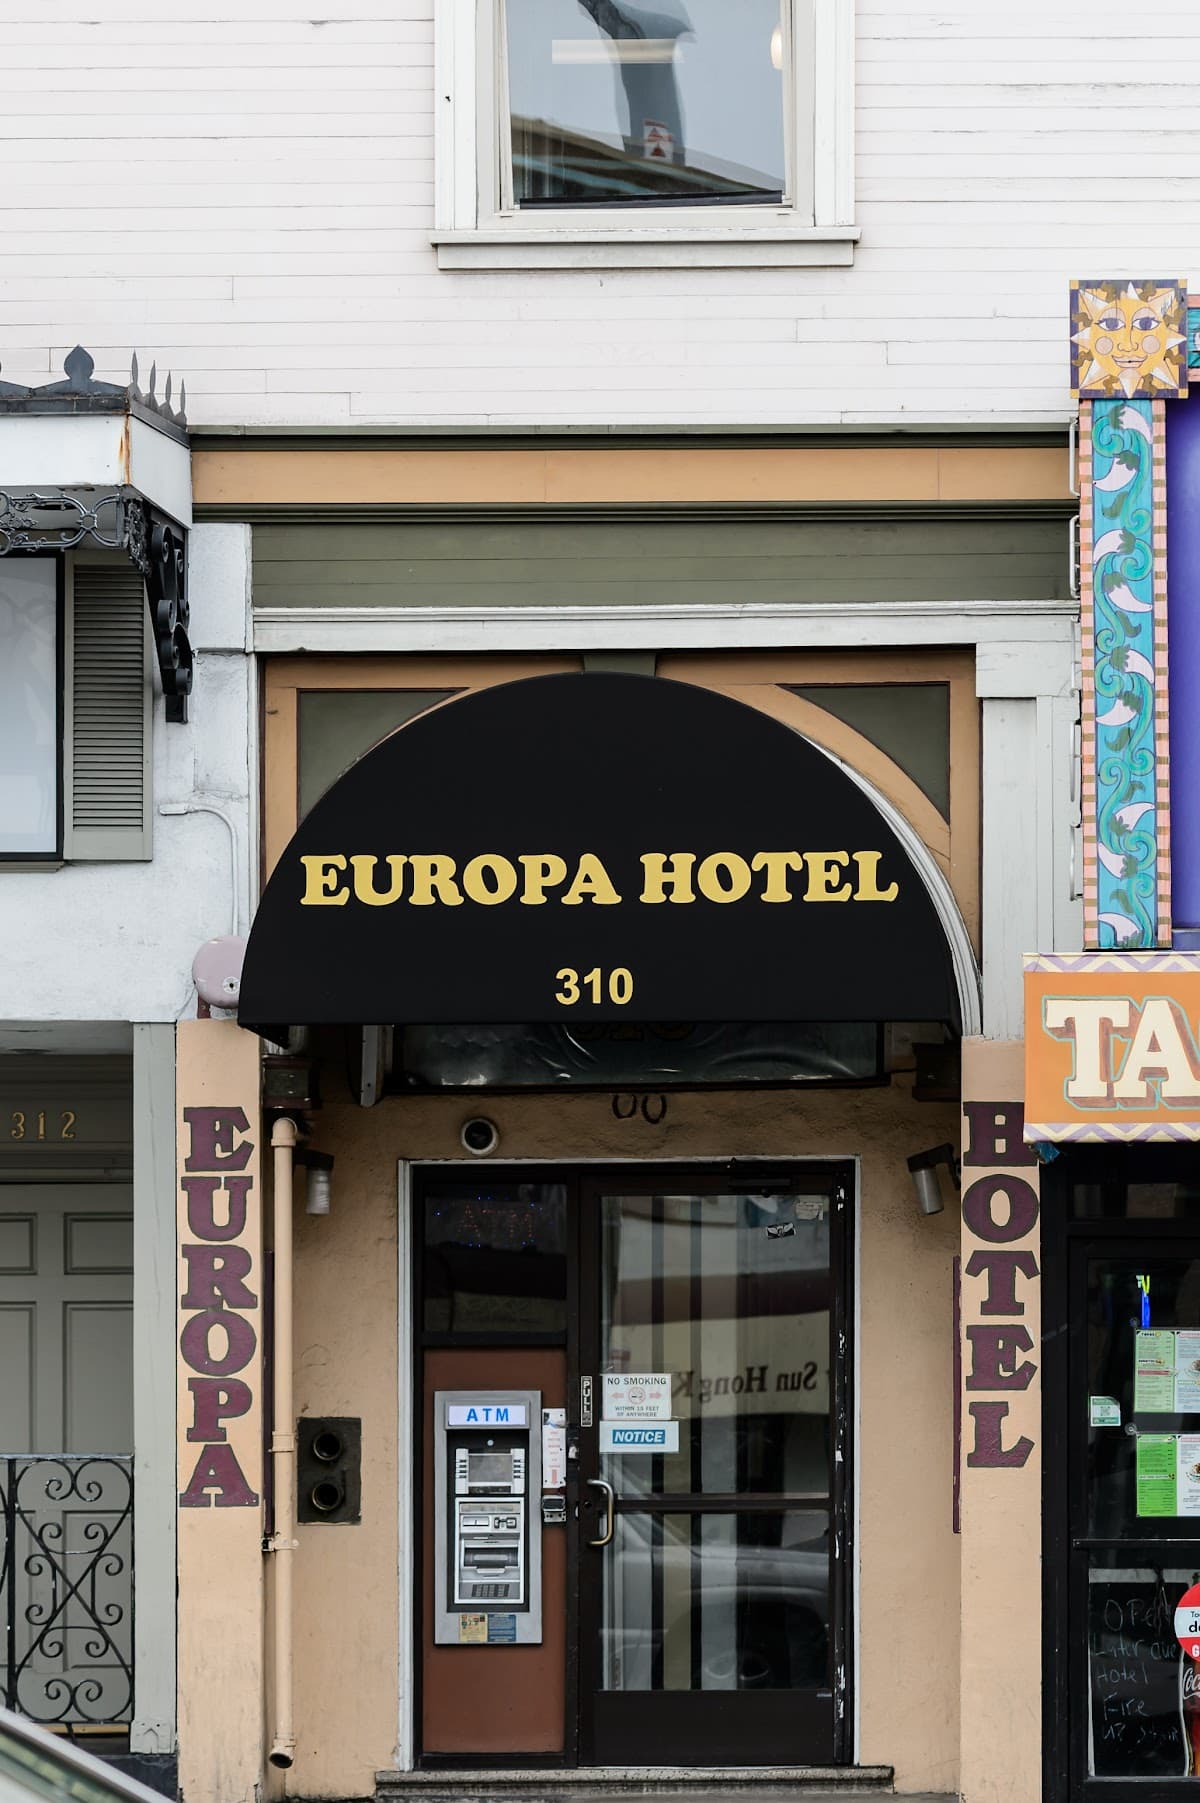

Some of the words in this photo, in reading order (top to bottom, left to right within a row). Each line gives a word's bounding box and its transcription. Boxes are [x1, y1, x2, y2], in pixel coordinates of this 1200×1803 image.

[299, 853, 622, 906] EUROPA
[638, 849, 899, 904] HOTEL
[554, 967, 634, 1006] 310
[11, 1111, 76, 1140] 312
[962, 1101, 1040, 1468] HOTEL
[179, 1106, 260, 1508] EUROPA
[583, 1380, 591, 1413] PULL
[607, 1377, 620, 1385] NO
[624, 1377, 667, 1385] SMOKING
[466, 1407, 509, 1422] ATM
[614, 1431, 663, 1443] NOTICE
